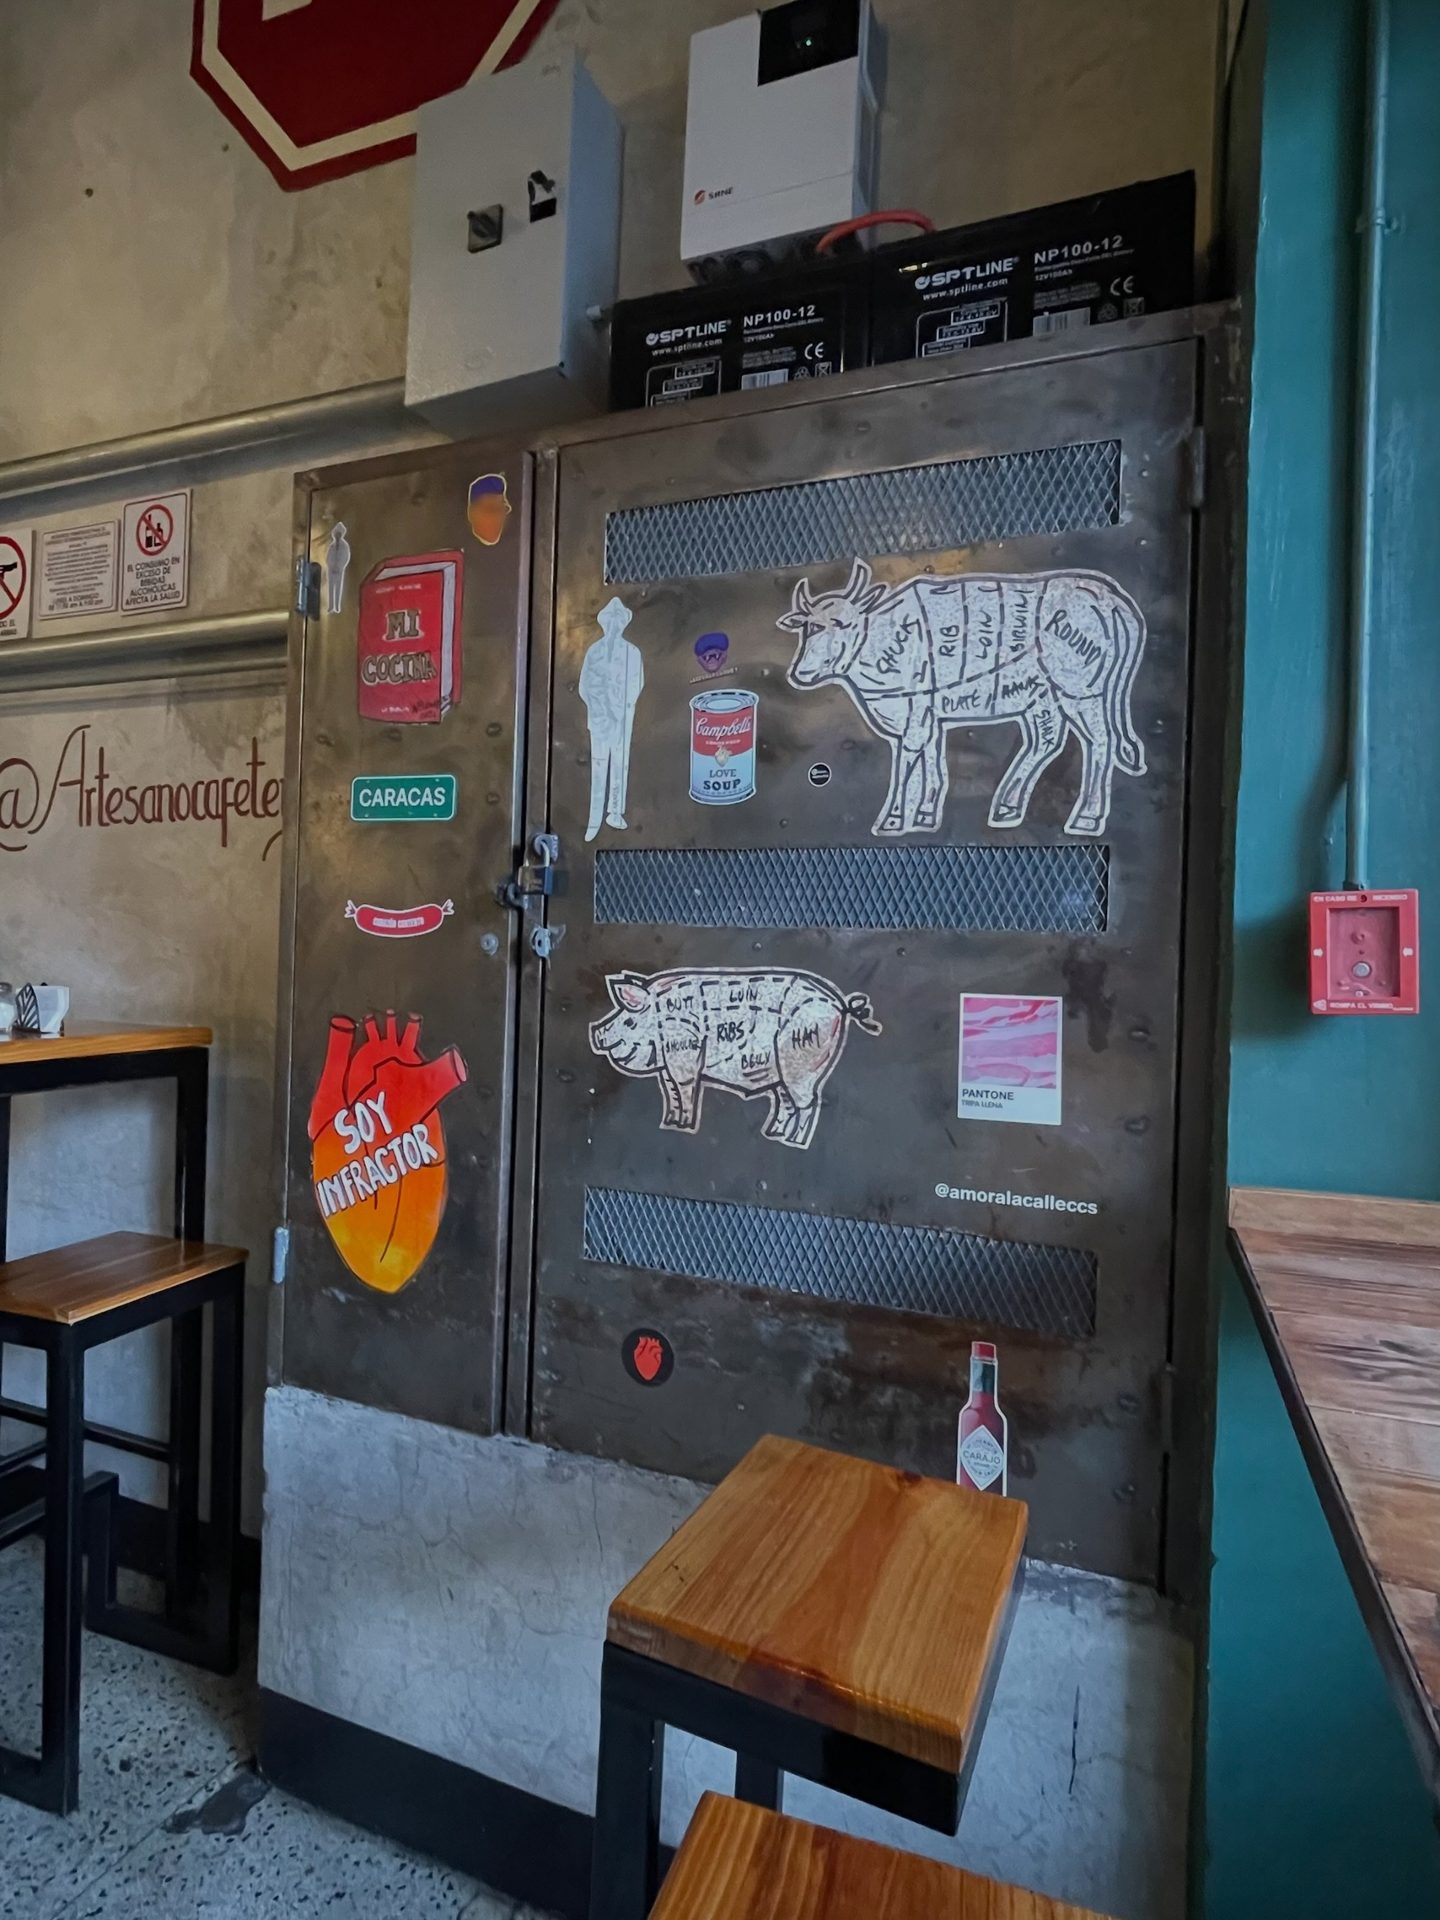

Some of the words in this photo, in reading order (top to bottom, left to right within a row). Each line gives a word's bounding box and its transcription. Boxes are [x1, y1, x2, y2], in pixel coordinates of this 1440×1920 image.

[1034, 234, 1123, 264] NP100-12
[922, 277, 1008, 301] www.sptline.com
[743, 304, 816, 328] NP100-12
[652, 338, 723, 357] www.sptline.com
[384, 610, 423, 640] MI
[976, 609, 994, 660] LOIN
[1044, 609, 1102, 669] ROUND
[876, 613, 923, 674] CHUCK
[938, 624, 960, 657] RIB
[361, 652, 438, 686] COCINA
[941, 689, 981, 714] PLATE
[0, 725, 285, 851] @Artesanocafete
[703, 779, 741, 792] SOUP
[709, 768, 737, 779] LOVE
[359, 787, 446, 807] CARACAS
[666, 995, 694, 1013] BUTT
[792, 1026, 820, 1048] HAM
[962, 1088, 1014, 1101] PANTONE
[334, 1090, 393, 1155] SOY
[315, 1122, 439, 1218] INFRACTOR
[934, 1182, 1099, 1215] @amoralacalleccs
